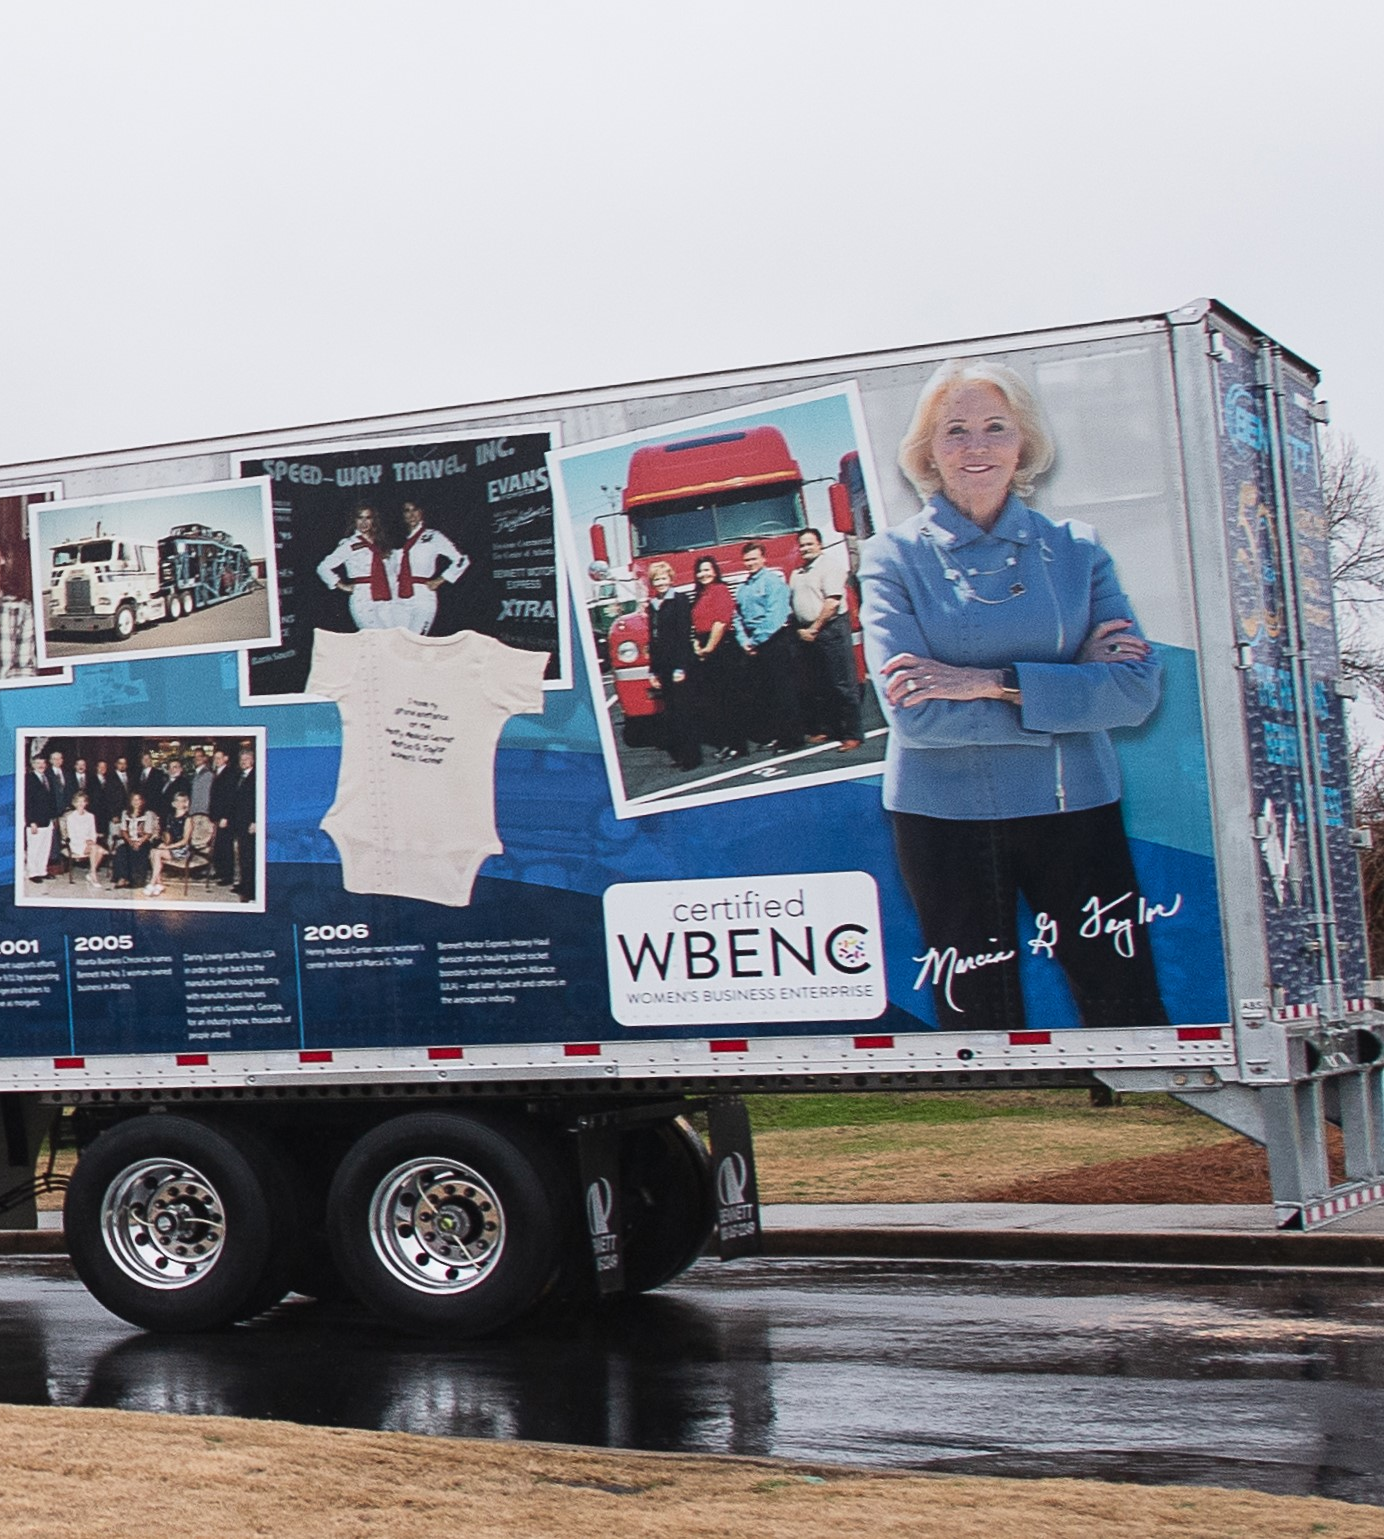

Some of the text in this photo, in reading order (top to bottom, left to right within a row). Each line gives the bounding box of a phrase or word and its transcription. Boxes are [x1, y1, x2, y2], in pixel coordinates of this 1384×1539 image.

[262, 459, 382, 487] SPEED-WAY
[476, 437, 515, 467] INC.
[487, 466, 550, 503] EVANS
[496, 599, 555, 621] XTRA
[672, 888, 806, 922] certified
[74, 935, 134, 951] 2005
[303, 923, 369, 941] 2006
[617, 923, 872, 982] WBENC
[912, 937, 1015, 1013] Marcia
[1080, 891, 1182, 958] Taylor
[627, 984, 874, 1005] WOMEN'S BUSINESS ENTERPRISE
[1242, 1001, 1263, 1010] ABS
